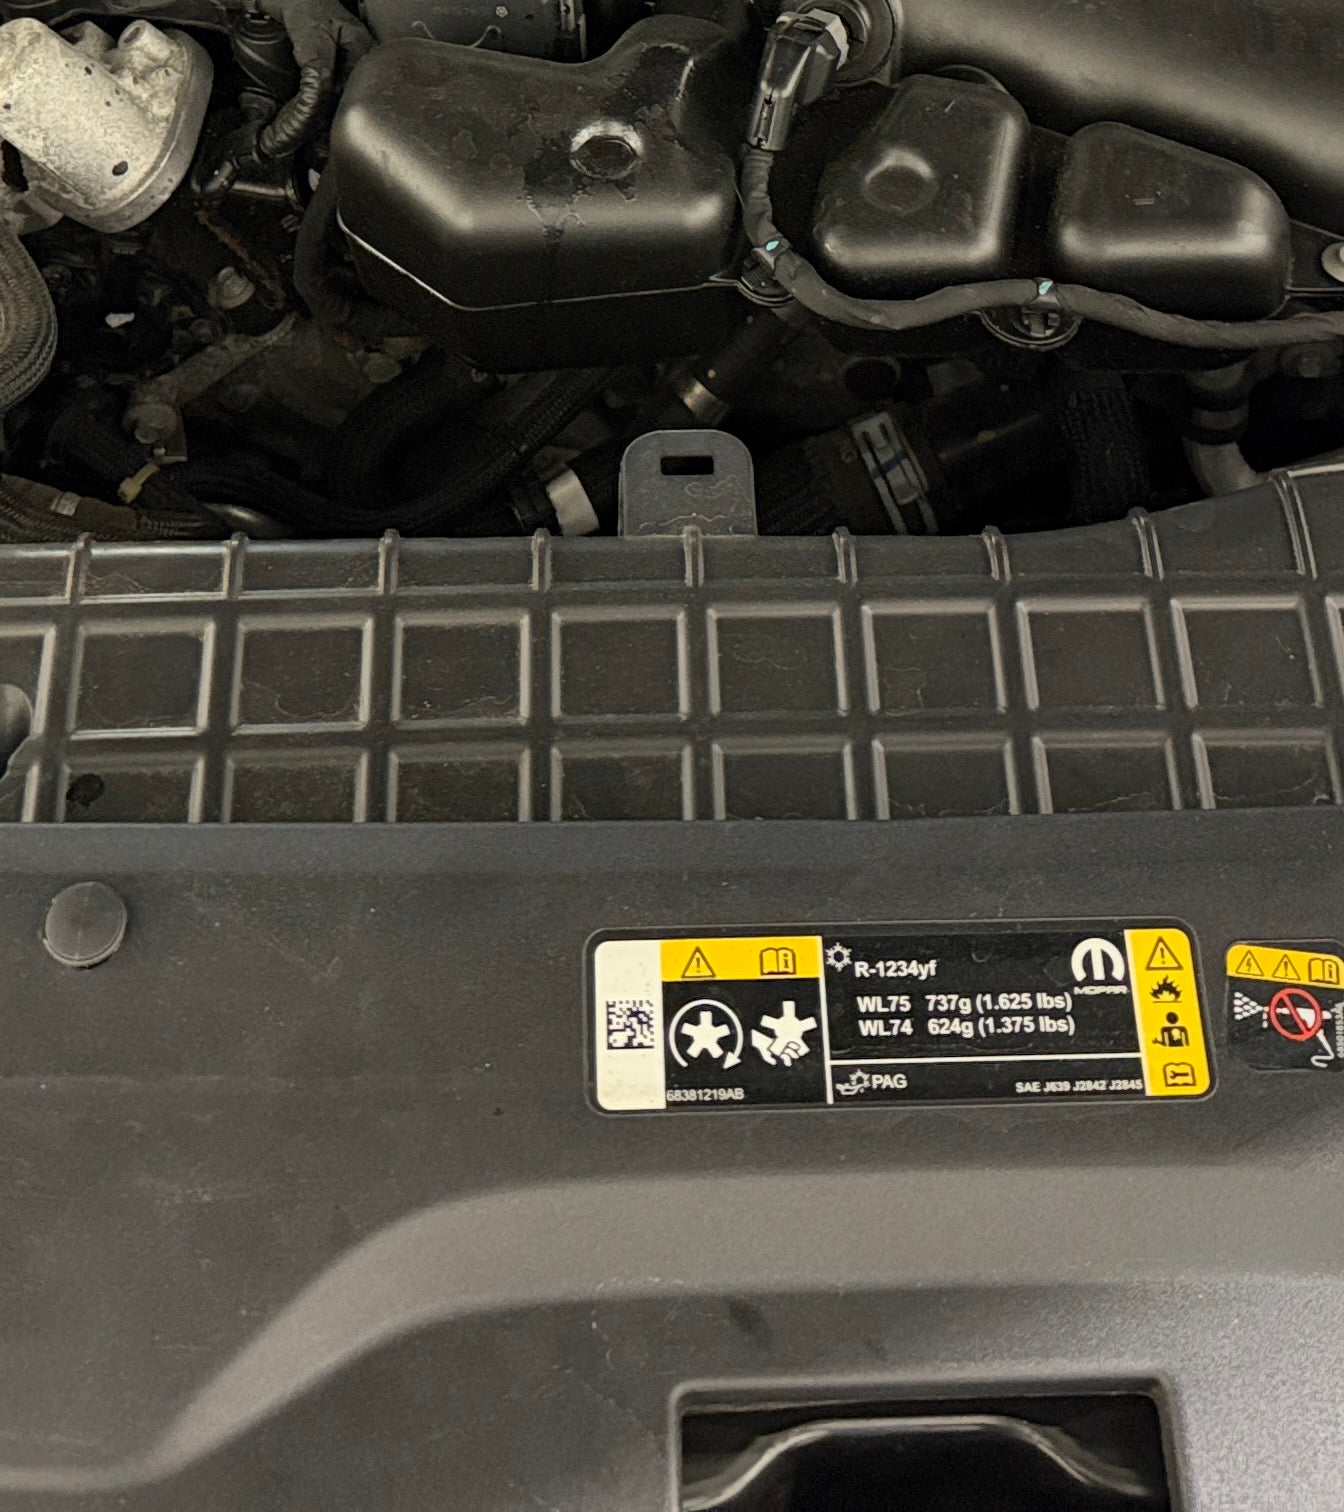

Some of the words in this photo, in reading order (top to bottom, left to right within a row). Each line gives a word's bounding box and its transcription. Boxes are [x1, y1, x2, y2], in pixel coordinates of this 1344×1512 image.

[854, 959, 938, 981] R-1234yf
[1073, 985, 1128, 996] MOPAR
[857, 995, 912, 1013] WL75
[924, 994, 973, 1015] 737g
[975, 993, 1033, 1014] (1.625
[1036, 992, 1073, 1013] lbs)
[858, 1018, 914, 1037] WL74
[927, 1017, 975, 1039] 624g
[977, 1017, 1036, 1038] (1.375
[1039, 1015, 1076, 1036] lbs)
[871, 1074, 908, 1090] PAG
[1015, 1081, 1041, 1094] SAE
[666, 1087, 745, 1102] 68381219AB
